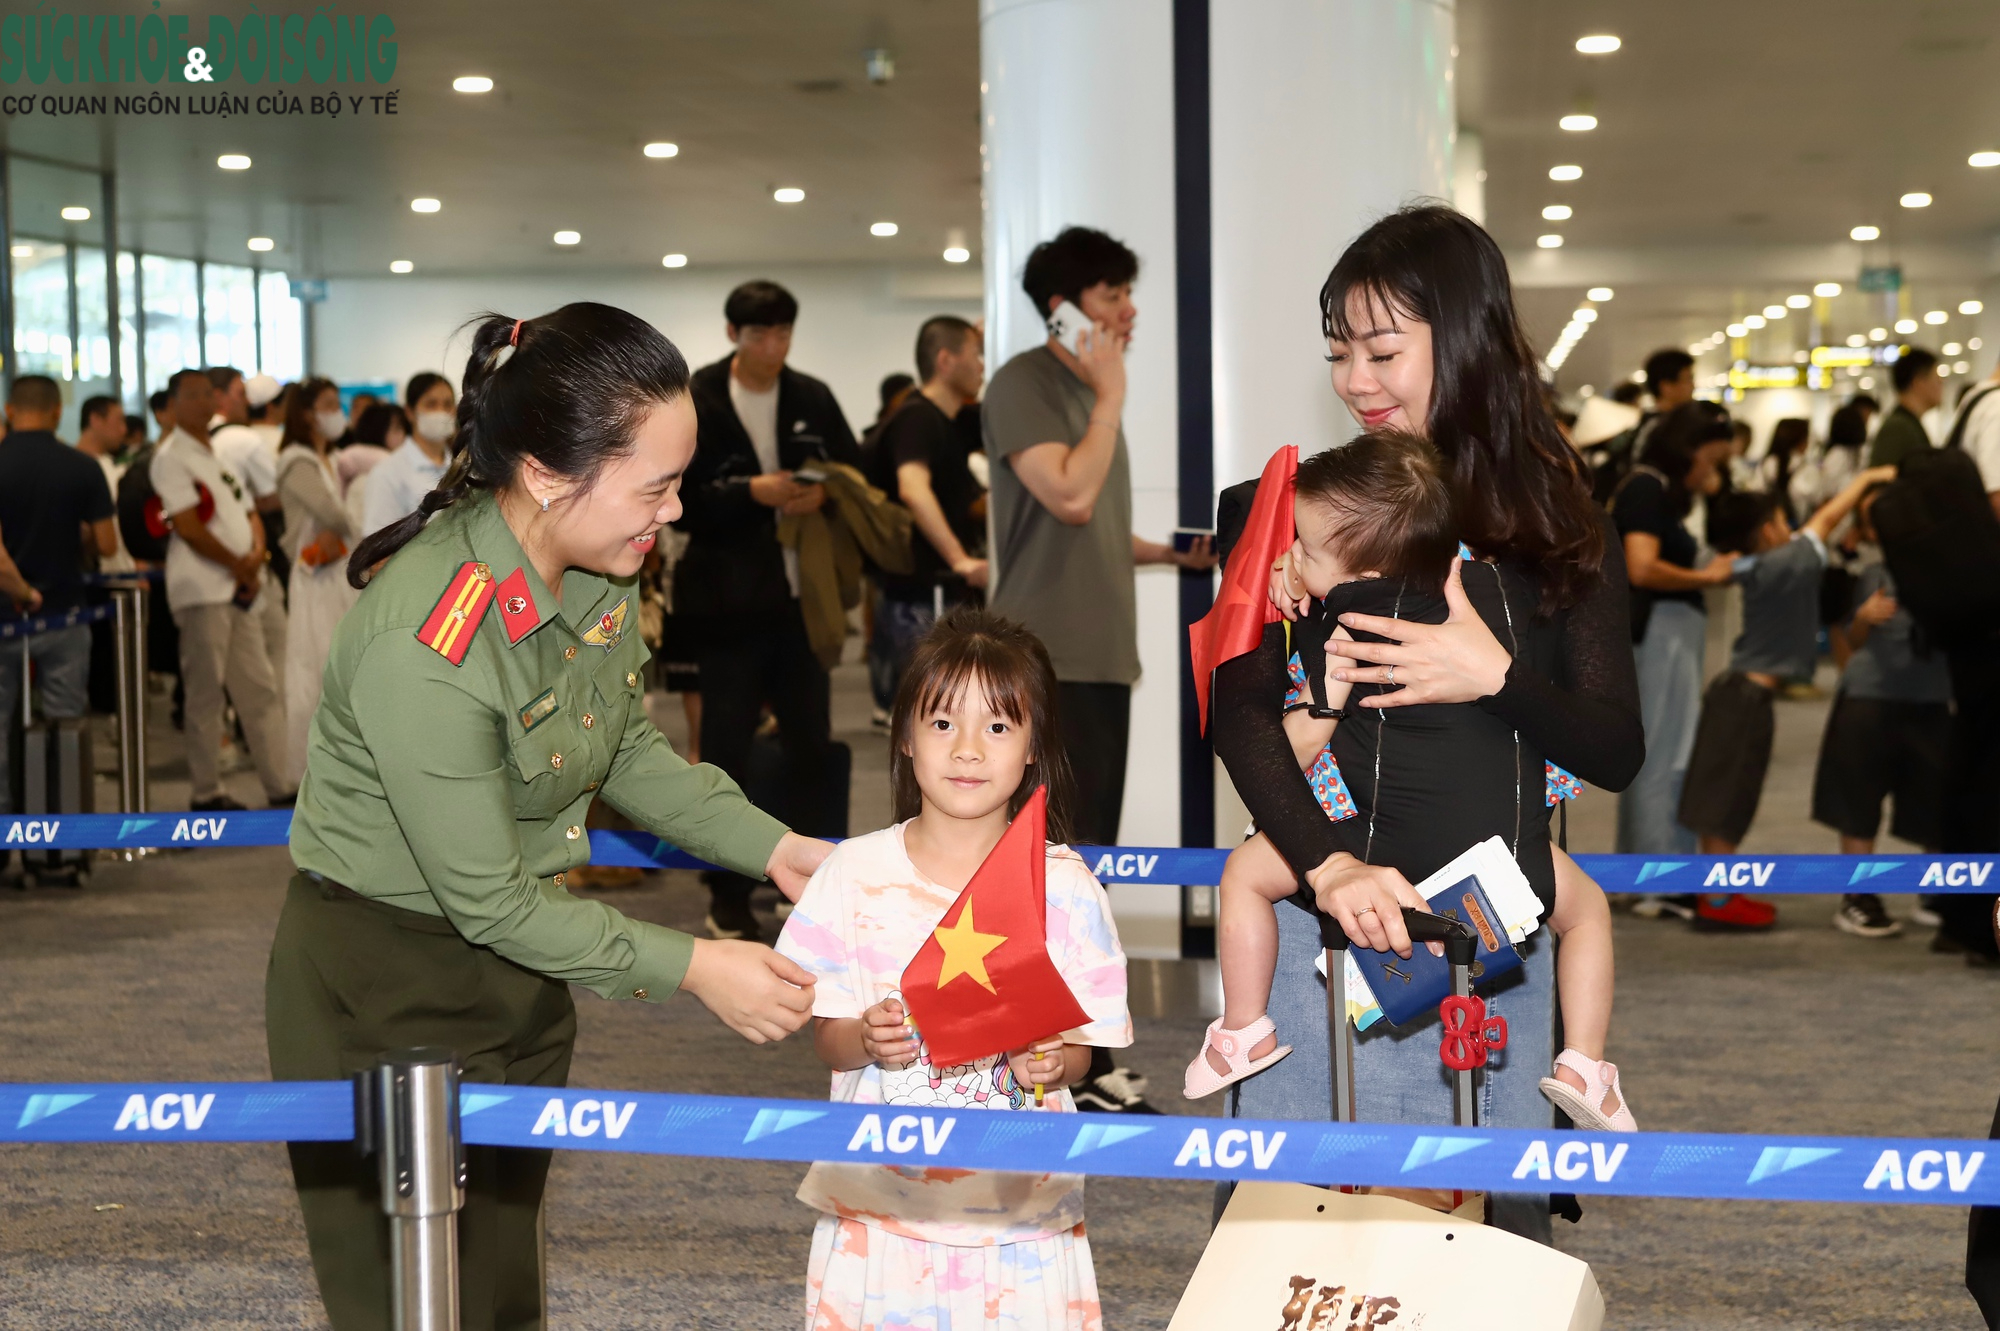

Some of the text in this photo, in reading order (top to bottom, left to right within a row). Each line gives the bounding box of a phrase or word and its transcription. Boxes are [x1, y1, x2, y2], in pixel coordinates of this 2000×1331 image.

[6, 821, 60, 843] ACV
[171, 818, 227, 841] ACV
[1094, 853, 1159, 878] ACV
[1703, 861, 1776, 887] ACV
[1918, 861, 1994, 887] ACV
[113, 1092, 215, 1131] ACV
[531, 1097, 638, 1139] ACV
[847, 1113, 957, 1156] ACV
[1173, 1127, 1287, 1171] ACV
[1512, 1140, 1629, 1183] ACV
[1862, 1149, 1986, 1192] ACV
